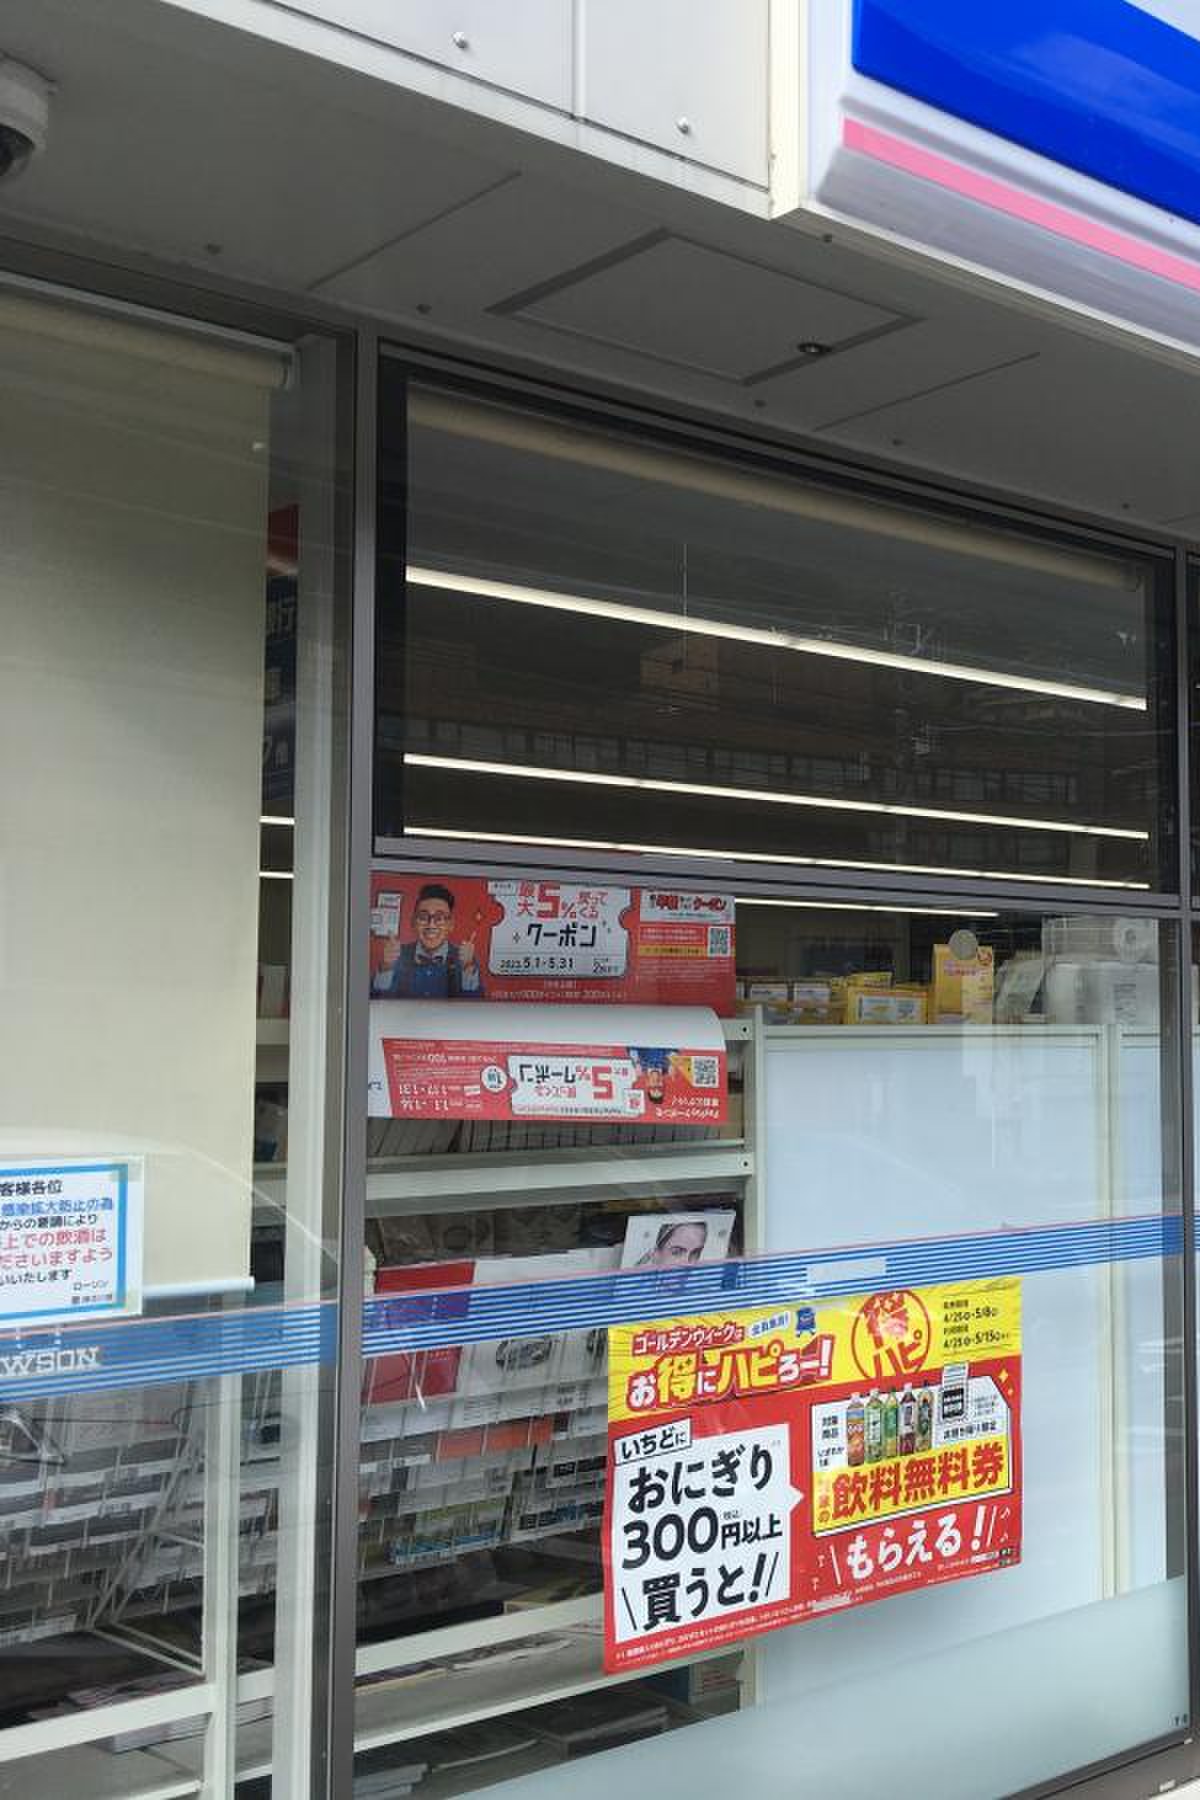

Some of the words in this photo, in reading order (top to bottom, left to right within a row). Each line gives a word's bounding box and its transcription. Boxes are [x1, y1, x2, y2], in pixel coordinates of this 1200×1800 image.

[527, 921, 597, 947] クーポン
[519, 1063, 577, 1085] クーポン
[634, 1323, 743, 1354] ゴールデンウィークは
[0, 1346, 99, 1376] WSON
[630, 1338, 833, 1408] お得にハピろー!
[621, 1425, 687, 1460] いちどに
[627, 1443, 773, 1514] おにぎり
[832, 1441, 1004, 1520] 飲料無料券
